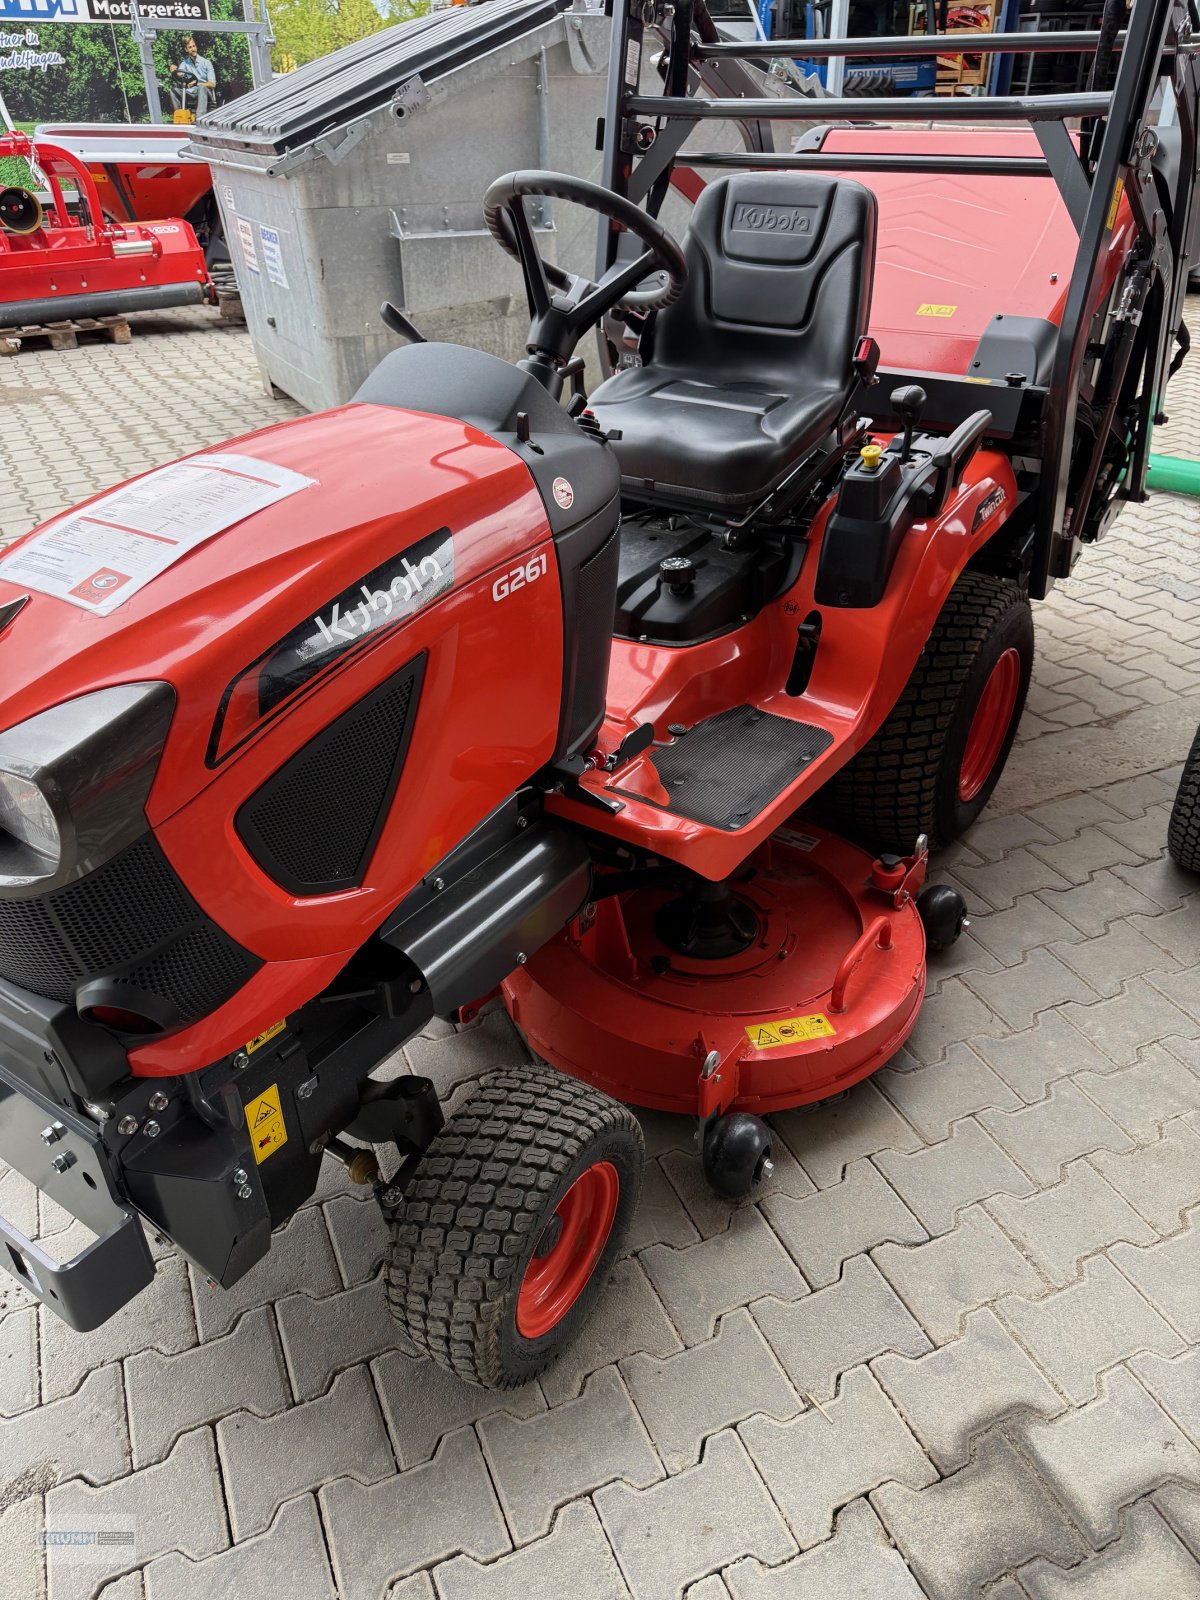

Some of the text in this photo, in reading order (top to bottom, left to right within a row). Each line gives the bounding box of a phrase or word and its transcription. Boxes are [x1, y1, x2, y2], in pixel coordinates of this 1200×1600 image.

[92, 0, 202, 18] Motrgeräte
[738, 206, 810, 232] Kubota
[492, 553, 547, 602] G261
[313, 554, 444, 644] Kubota
